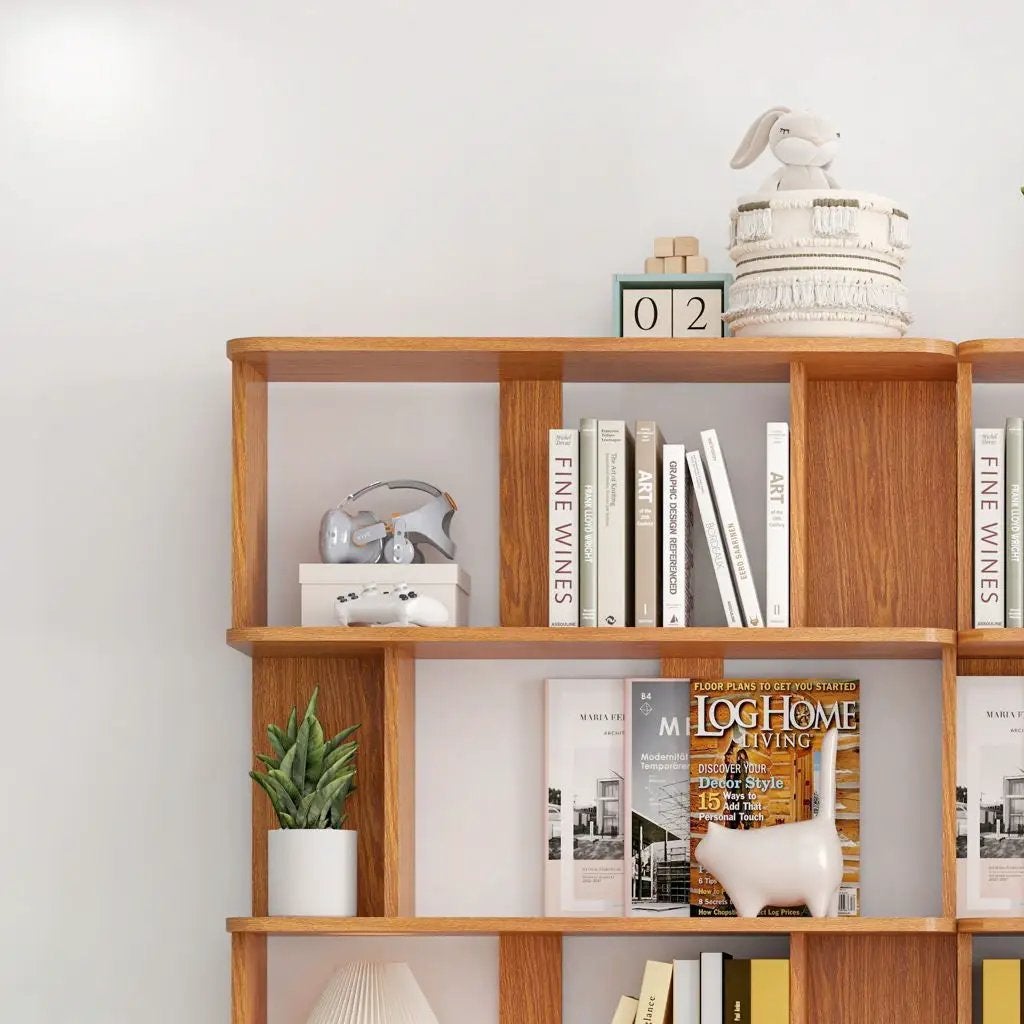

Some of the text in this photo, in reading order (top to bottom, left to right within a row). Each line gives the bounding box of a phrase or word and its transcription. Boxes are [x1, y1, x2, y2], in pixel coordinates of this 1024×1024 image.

[686, 296, 708, 330] 2
[555, 456, 572, 512] FINE
[637, 470, 653, 503] ART
[770, 471, 784, 505] ART
[981, 456, 999, 511] FINE
[668, 461, 677, 595] GRAPHIC DESIGN REFERENCED
[555, 523, 573, 604] WINES
[981, 522, 999, 604] WINES
[694, 682, 857, 691] FLOOR PLANS TO GET YOU STARTED
[742, 733, 813, 748] LIVING
[698, 764, 768, 774] DISCOVER YOUR
[698, 777, 784, 791] Decor Style
[723, 791, 757, 802] Ways to
[698, 793, 721, 811] 15
[723, 802, 762, 811] Add That
[699, 812, 764, 822] Personal Touch
